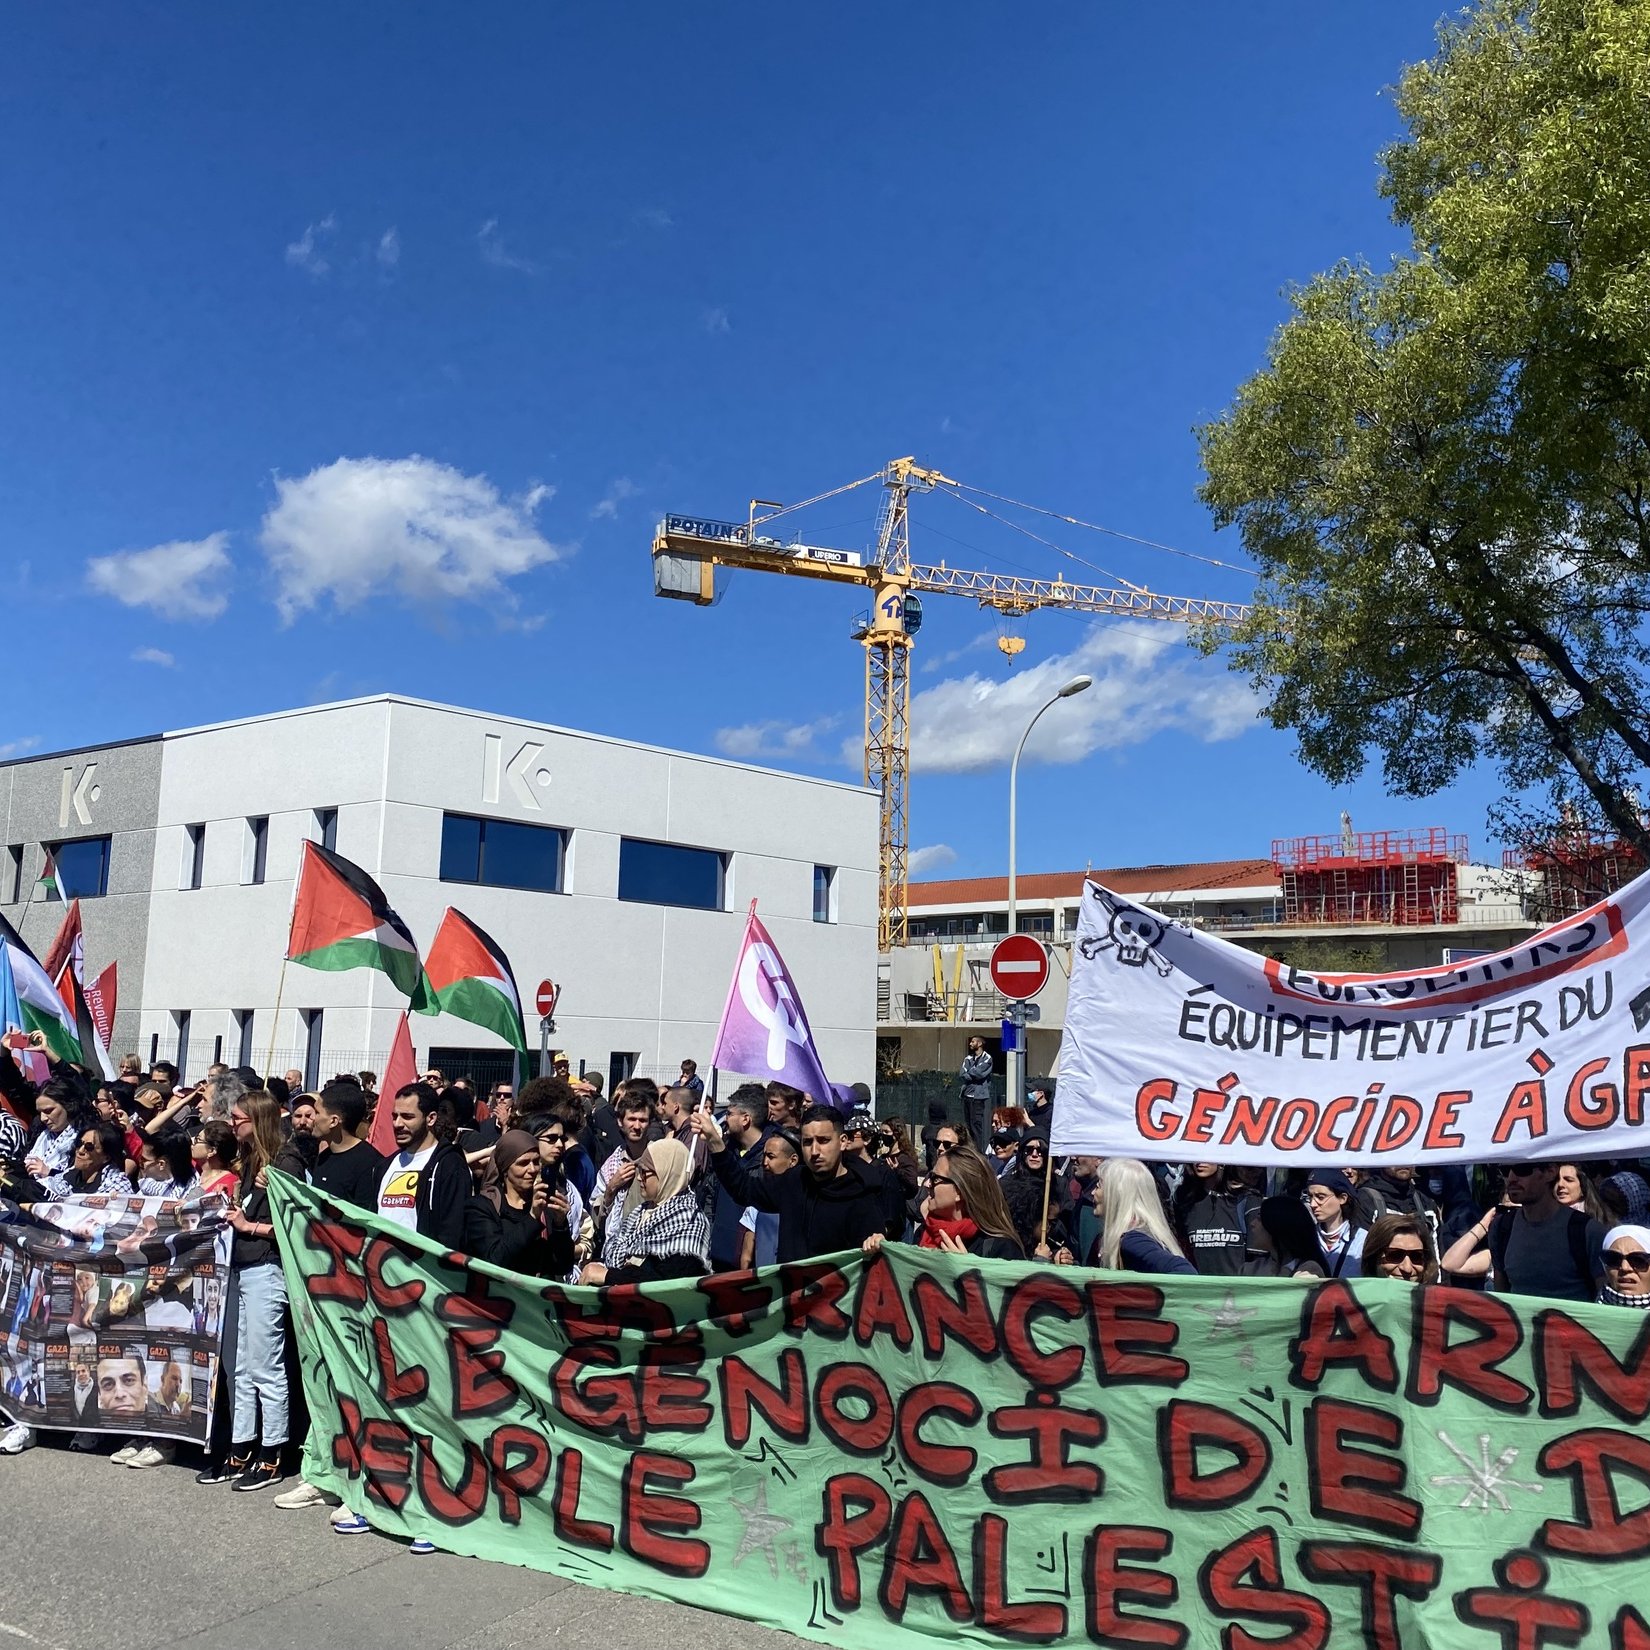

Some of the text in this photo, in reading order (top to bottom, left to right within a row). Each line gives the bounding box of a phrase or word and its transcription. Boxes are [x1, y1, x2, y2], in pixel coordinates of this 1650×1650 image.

[671, 517, 733, 538] POTAIN
[814, 550, 842, 561] UPERIO
[1559, 970, 1613, 1031] DU
[1135, 1071, 1473, 1153] GÉNOCIDE
[1492, 1048, 1556, 1145] À
[696, 1252, 1191, 1391] FRANCE
[46, 1345, 69, 1353] GAZA
[98, 1345, 121, 1354] GAZA
[149, 1347, 169, 1356] GAZA
[370, 1314, 523, 1422] LE
